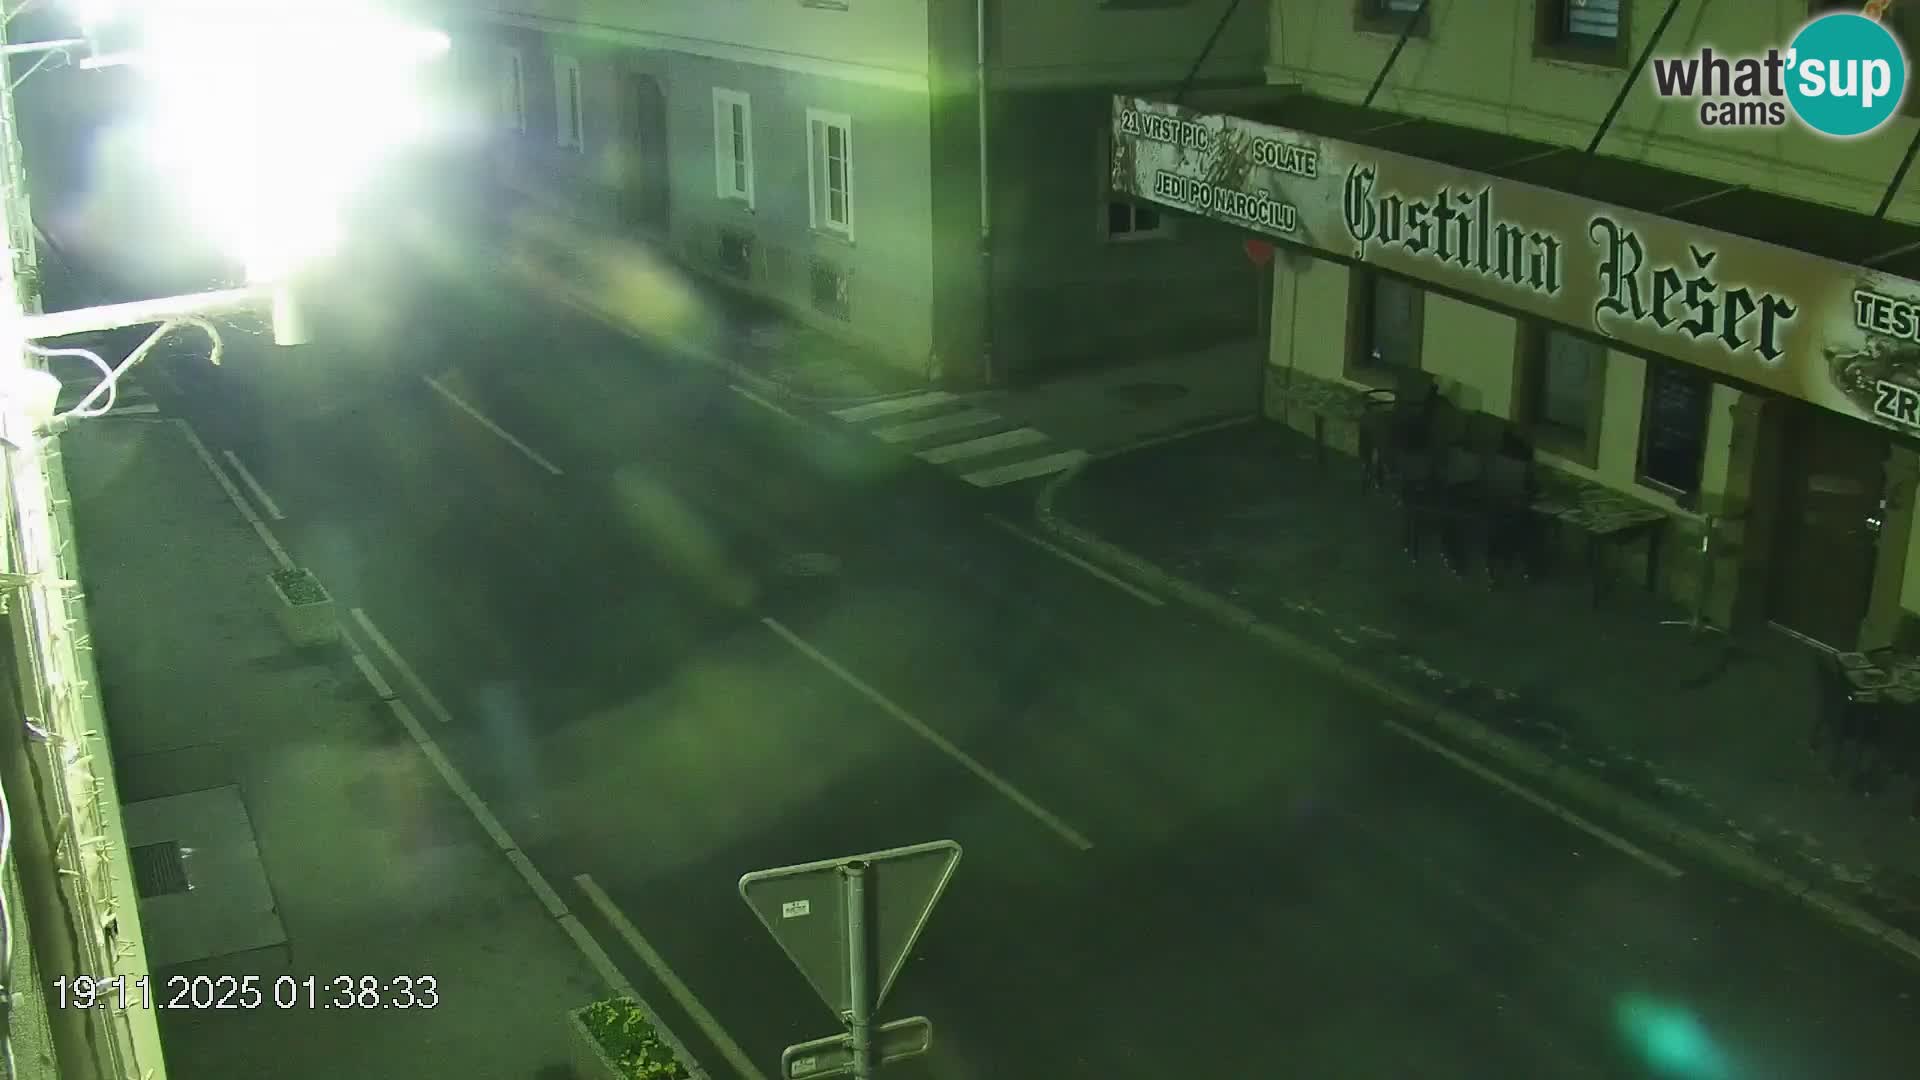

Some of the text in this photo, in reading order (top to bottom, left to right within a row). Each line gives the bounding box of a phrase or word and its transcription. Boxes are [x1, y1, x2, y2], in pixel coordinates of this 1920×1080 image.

[1122, 110, 1208, 150] 21 VRST PIC
[1253, 139, 1317, 177] SOLATE
[1156, 171, 1296, 231] JEDI PO NAROČILU
[1344, 162, 1797, 361] Gostilna Rešer
